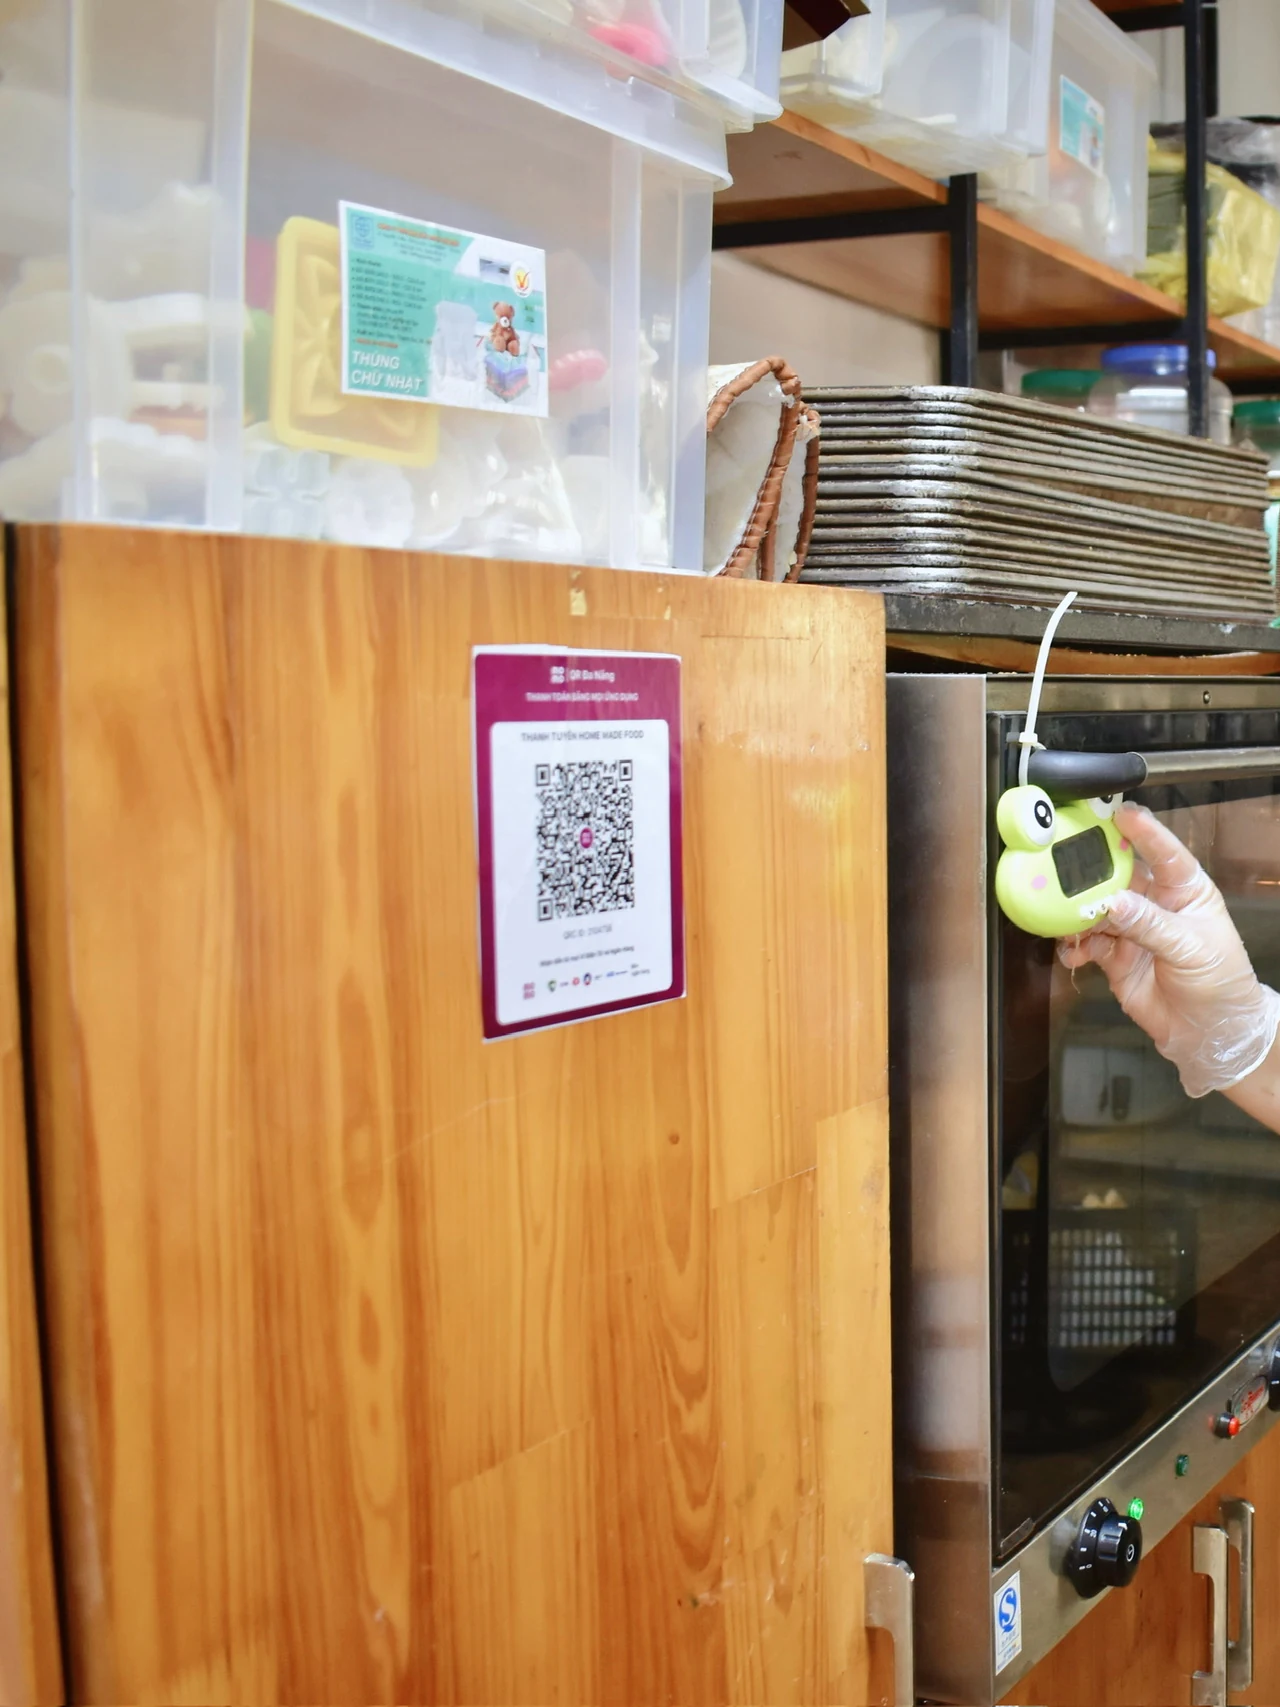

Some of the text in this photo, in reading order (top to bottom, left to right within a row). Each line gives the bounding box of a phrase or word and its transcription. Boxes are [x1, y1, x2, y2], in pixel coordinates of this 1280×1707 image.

[521, 731, 549, 741] THANH
[579, 731, 600, 740] HOME
[602, 730, 622, 739] MADE
[624, 729, 644, 739] FOOD
